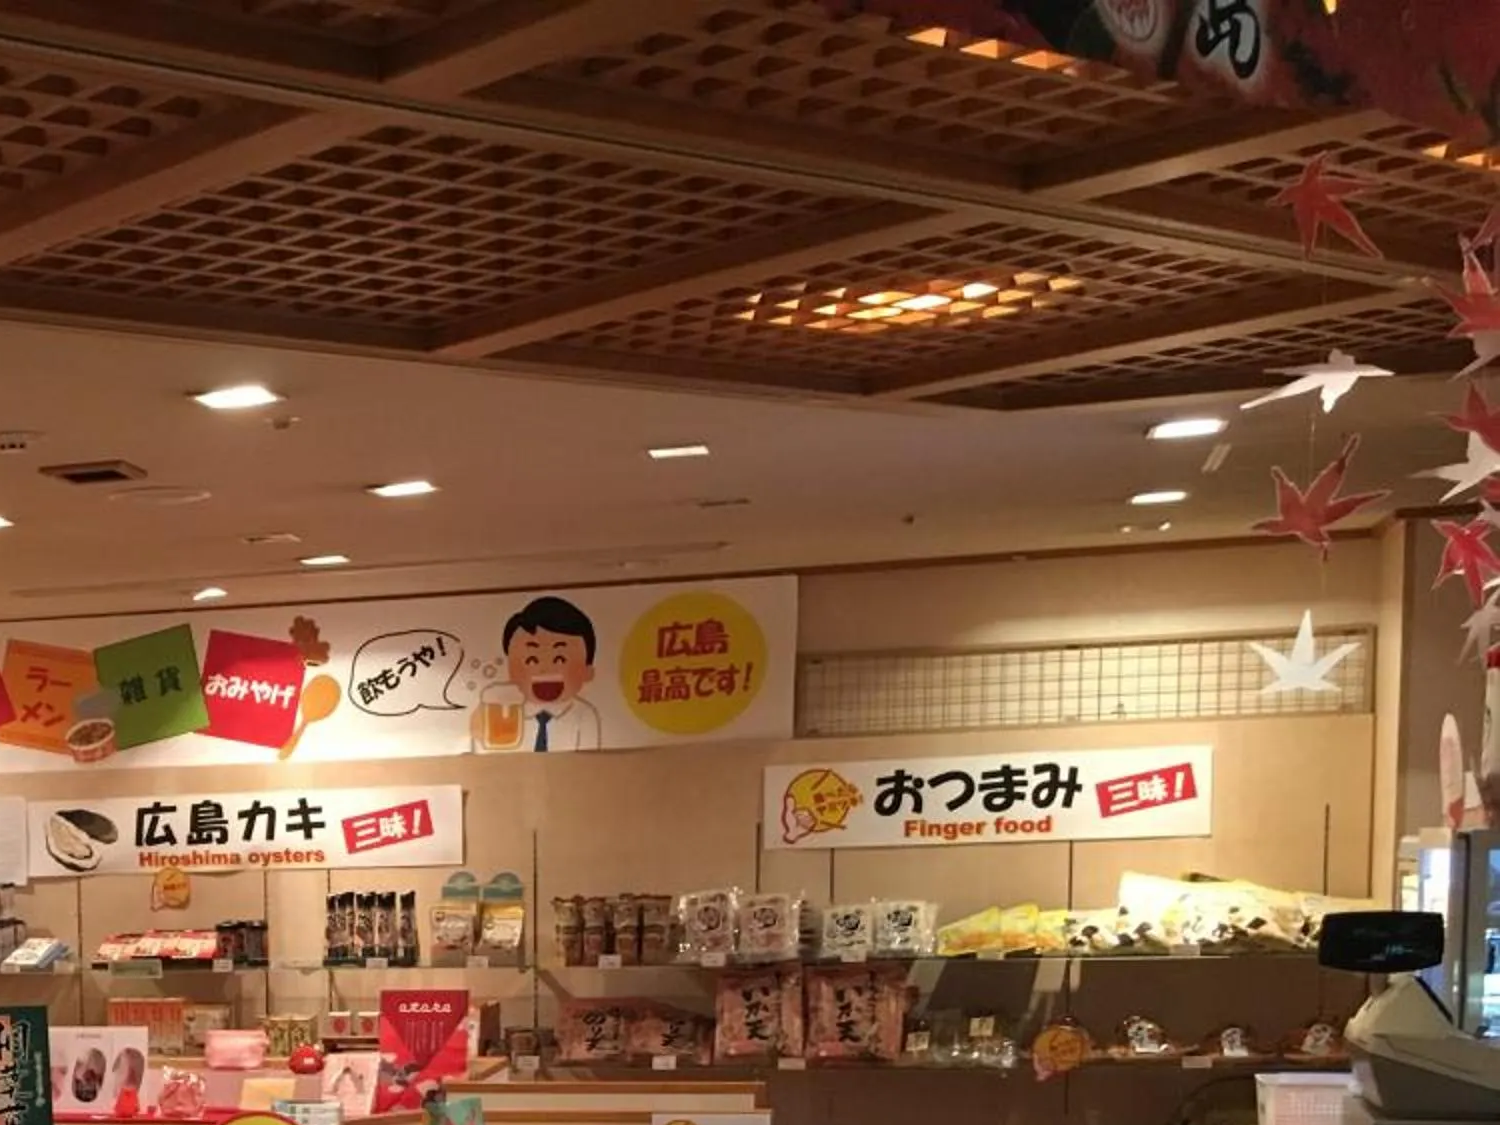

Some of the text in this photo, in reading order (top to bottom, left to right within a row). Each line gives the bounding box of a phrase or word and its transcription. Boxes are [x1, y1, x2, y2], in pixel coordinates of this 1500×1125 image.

[657, 618, 730, 658] 広島
[118, 665, 182, 706] 雑貨
[206, 674, 297, 709] おみやげ
[638, 661, 753, 704] 最高です!
[874, 763, 1082, 816] おつまみ
[135, 798, 326, 847] 広島カキ
[904, 815, 1052, 841] Finger food
[139, 847, 326, 867] Hiroshima oysters
